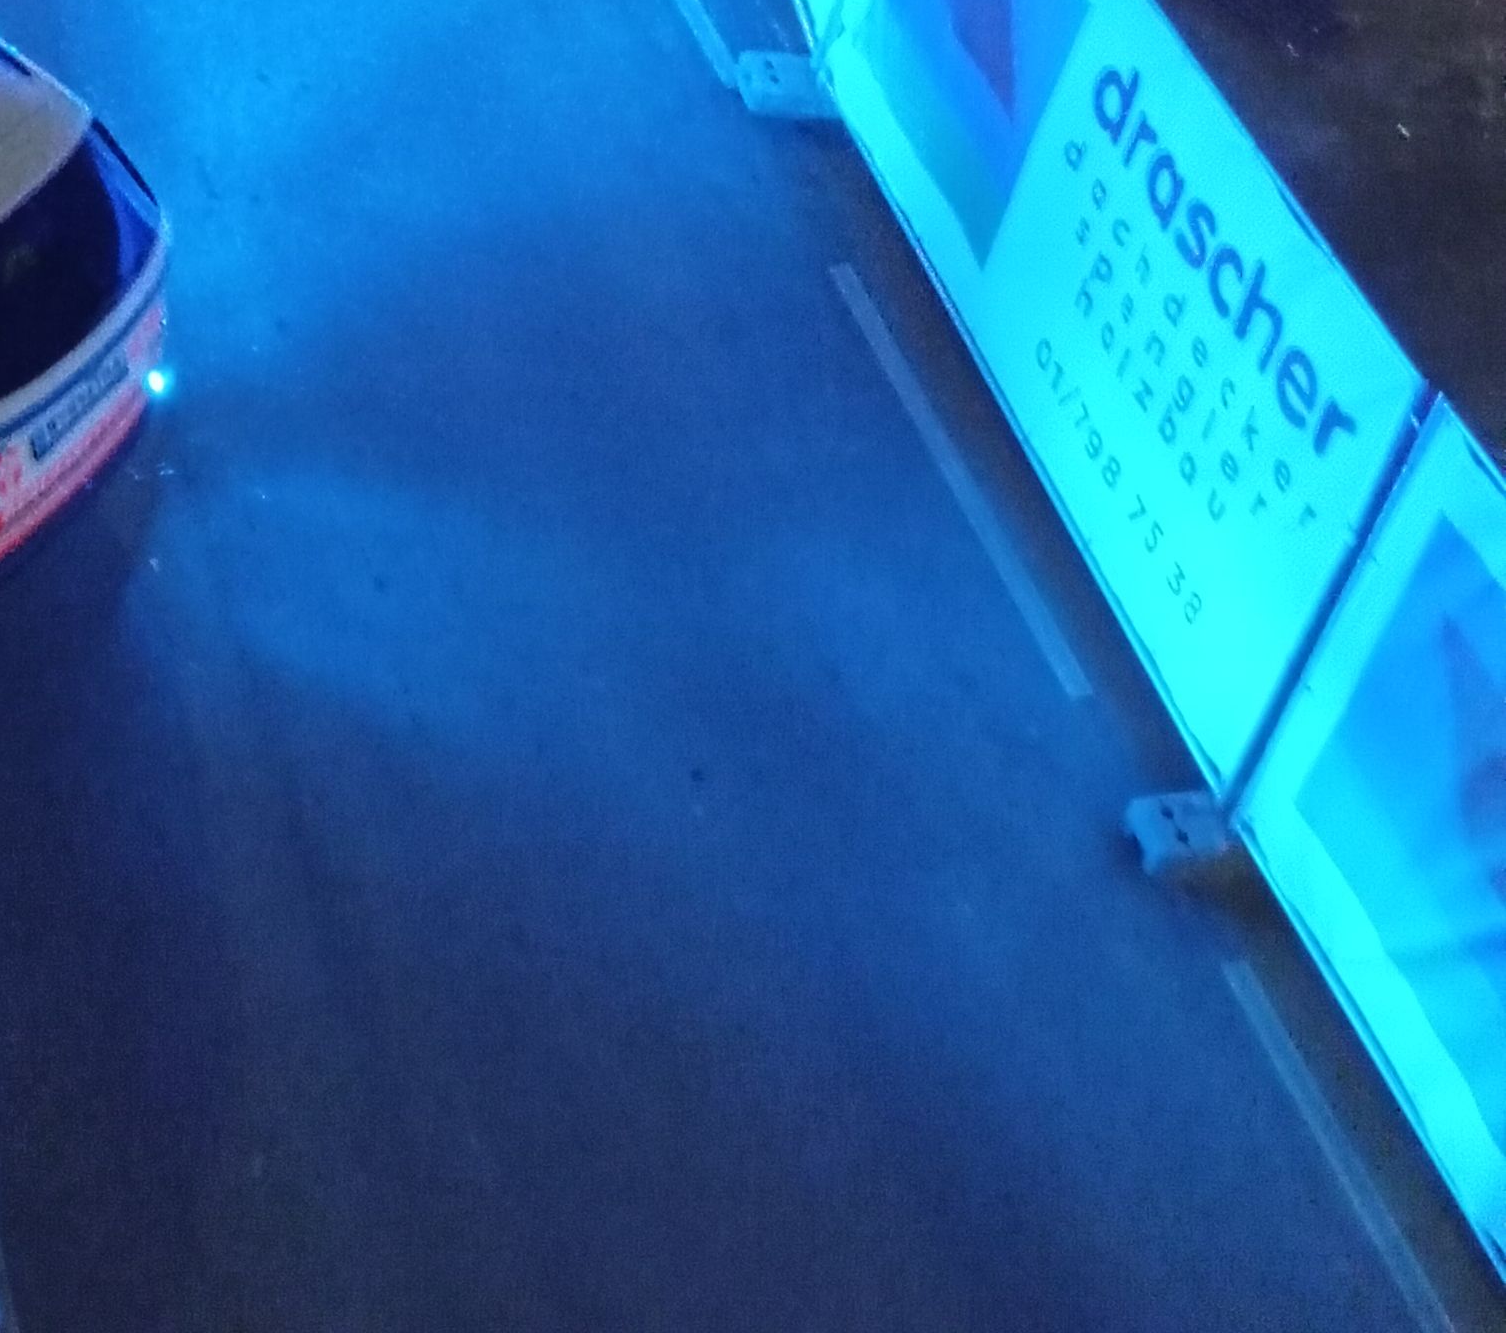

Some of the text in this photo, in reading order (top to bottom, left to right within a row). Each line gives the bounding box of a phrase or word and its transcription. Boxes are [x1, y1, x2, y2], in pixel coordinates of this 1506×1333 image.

[1062, 138, 1318, 529] dachdecker
[1073, 276, 1226, 523] holzbau
[1074, 215, 1268, 517] spengler
[1093, 66, 1357, 456] drascher
[1034, 337, 1203, 626] 01/798 75 38
